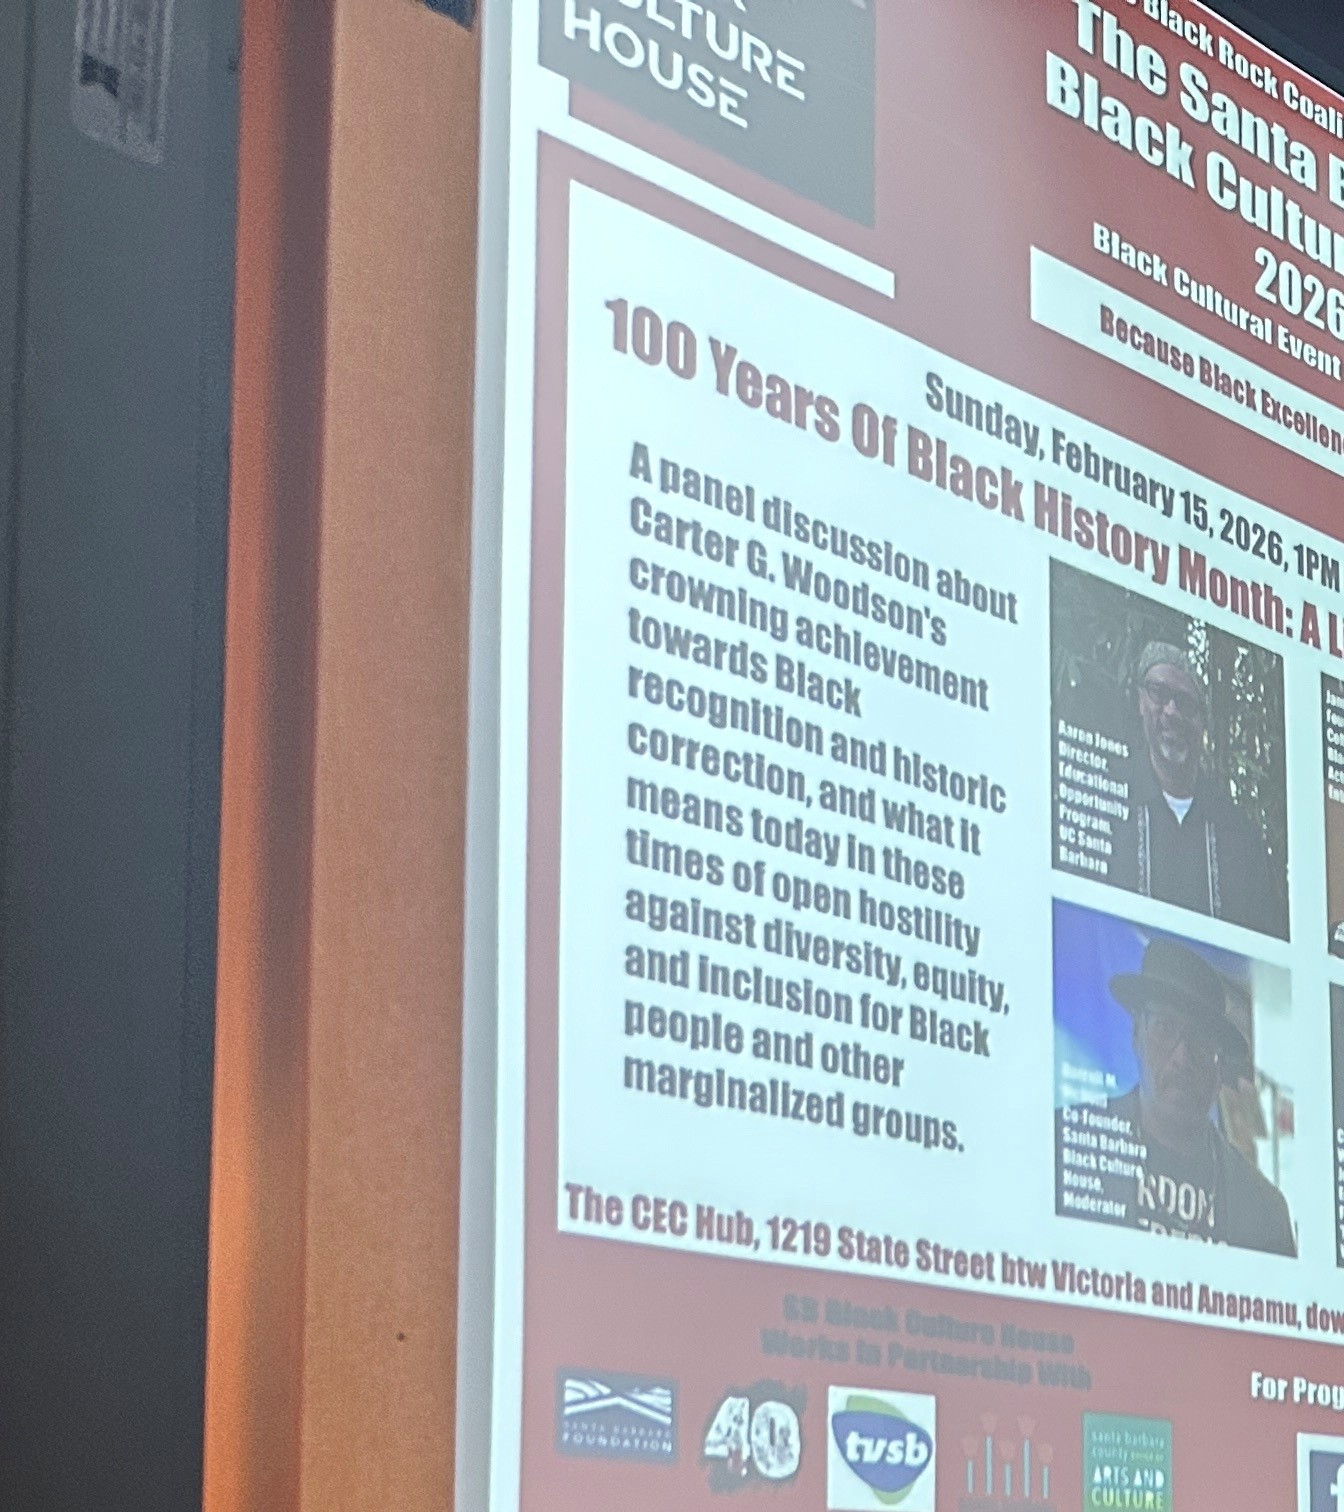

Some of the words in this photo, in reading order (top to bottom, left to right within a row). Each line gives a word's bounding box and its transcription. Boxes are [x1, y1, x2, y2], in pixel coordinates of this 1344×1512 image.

[564, 0, 748, 128] HOUSE
[1071, 0, 1167, 96] The
[1179, 63, 1317, 190] Santa
[1143, 0, 1214, 57] Black
[1219, 36, 1278, 99] Rock
[1045, 50, 1195, 189] Black
[1093, 222, 1169, 287] Black
[1174, 267, 1273, 344] Cultural
[1277, 325, 1342, 380] Event
[1099, 303, 1195, 377] Because
[1199, 354, 1258, 409] Black
[604, 298, 698, 380] 100
[709, 335, 841, 444] Years
[851, 401, 898, 467] Of
[907, 423, 1025, 522] Black
[1033, 480, 1171, 587] History
[1178, 543, 1294, 640] Month:
[1299, 600, 1322, 650] A
[628, 441, 653, 485] A
[659, 457, 756, 524] panel
[762, 495, 930, 592] discussion
[936, 567, 1019, 625] about
[925, 371, 1046, 462] Sunday,
[1051, 427, 1176, 518] February
[1180, 489, 1214, 539] 15,
[1219, 507, 1289, 573] 2026,
[1293, 543, 1341, 593] 1PM
[628, 496, 740, 568] Carter
[746, 537, 776, 584] G.
[781, 551, 948, 647] Woodson's
[564, 1183, 624, 1227] The
[631, 1193, 688, 1237] CEC
[695, 1203, 761, 1252] Hub,
[766, 1214, 832, 1259] 1219
[837, 1225, 910, 1270] State
[915, 1237, 995, 1284] Street
[1001, 1250, 1047, 1290] btw
[1052, 1258, 1147, 1304] Victoria
[1151, 1278, 1194, 1312] and
[1198, 1283, 1302, 1331] Anapamu,
[846, 1430, 929, 1467] tvsb
[1250, 1370, 1288, 1403] For
[1091, 1486, 1164, 1511] CULTURE
[1093, 1465, 1130, 1487] ARTS
[1134, 1467, 1165, 1490] AND
